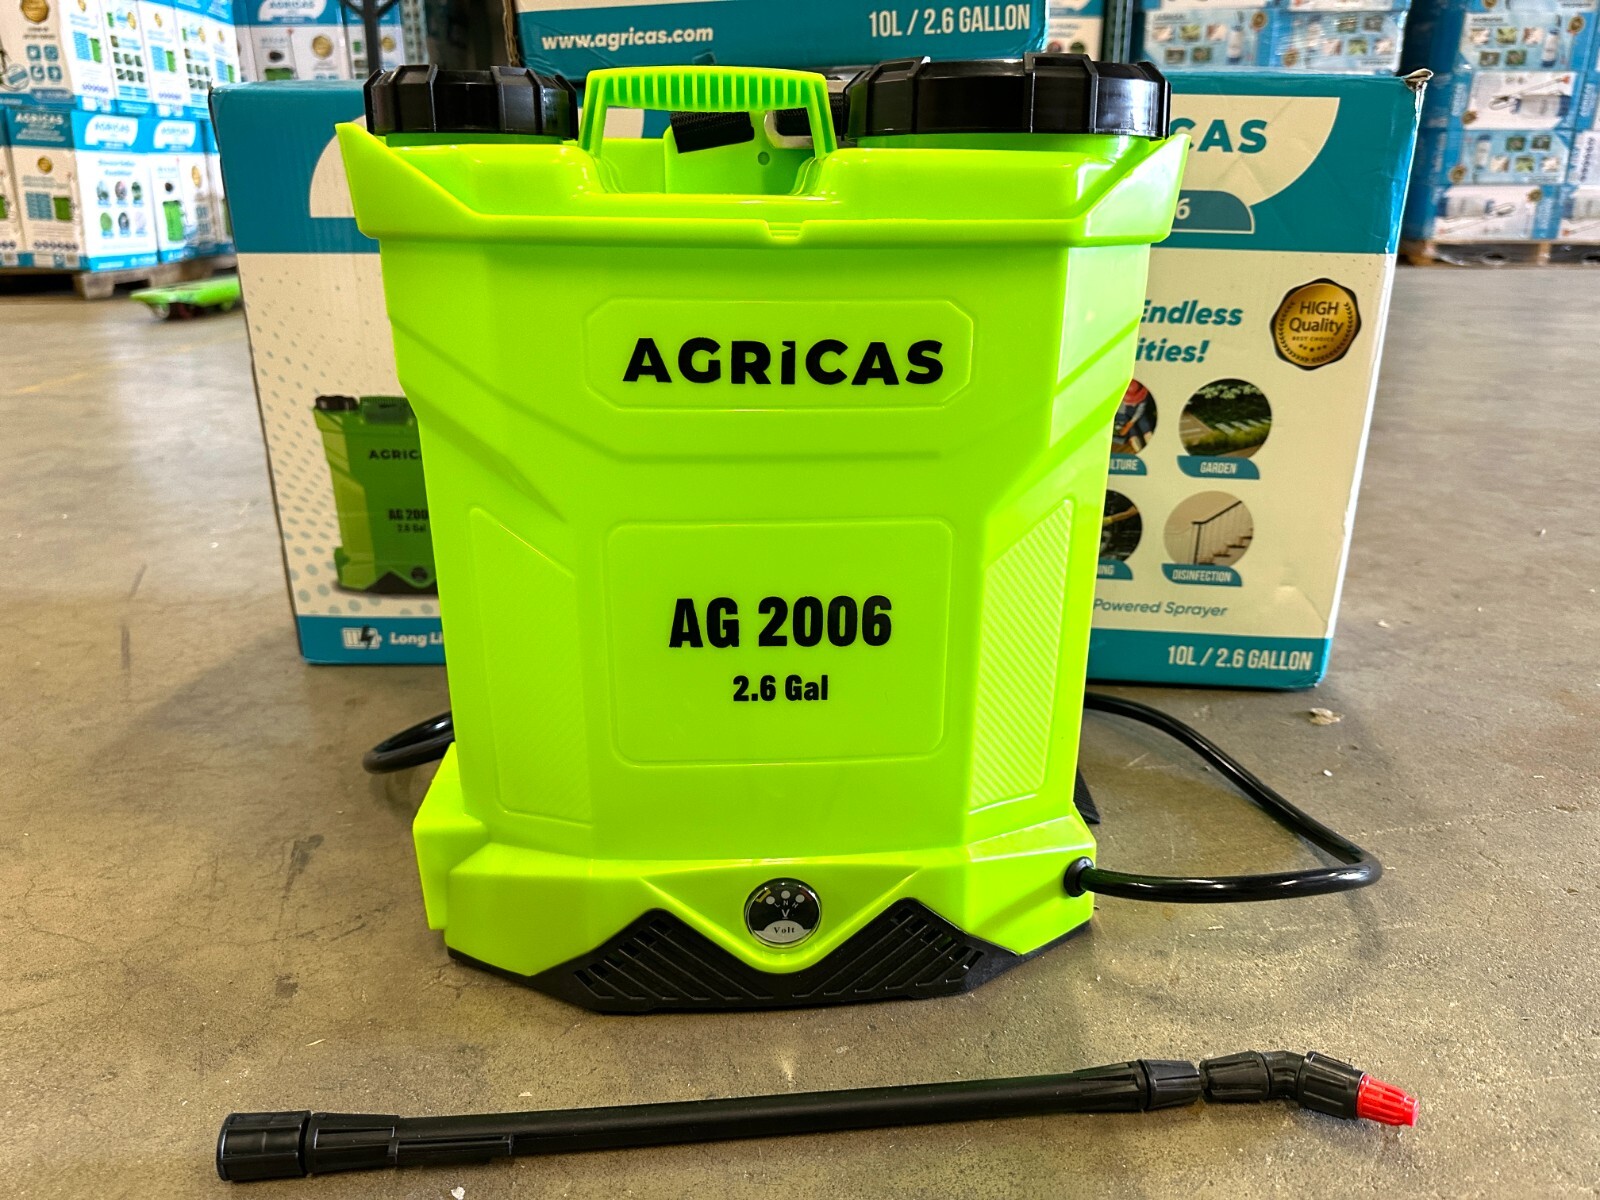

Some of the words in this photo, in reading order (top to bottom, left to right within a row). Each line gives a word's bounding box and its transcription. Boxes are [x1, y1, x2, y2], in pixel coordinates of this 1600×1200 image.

[869, 10, 902, 38] 10L
[906, 9, 919, 36] /
[923, 8, 954, 35] 2.6
[958, 4, 1031, 33] GALLON
[541, 26, 714, 51] www.agricas.com
[1299, 301, 1340, 316] HIGH
[1288, 316, 1345, 337] Quality
[1200, 461, 1237, 475] GARDEN
[1171, 568, 1232, 583] DISINFECTION
[1093, 598, 1162, 614] Powered
[1164, 601, 1228, 619] Sprayer
[668, 596, 740, 649] AG
[757, 594, 893, 648] 2006
[390, 631, 428, 649] Long
[1167, 645, 1197, 667] 10L
[1215, 647, 1245, 668] 2.6
[1247, 649, 1313, 671] GALLON
[732, 674, 777, 702] 2.6
[784, 674, 829, 701] Gal
